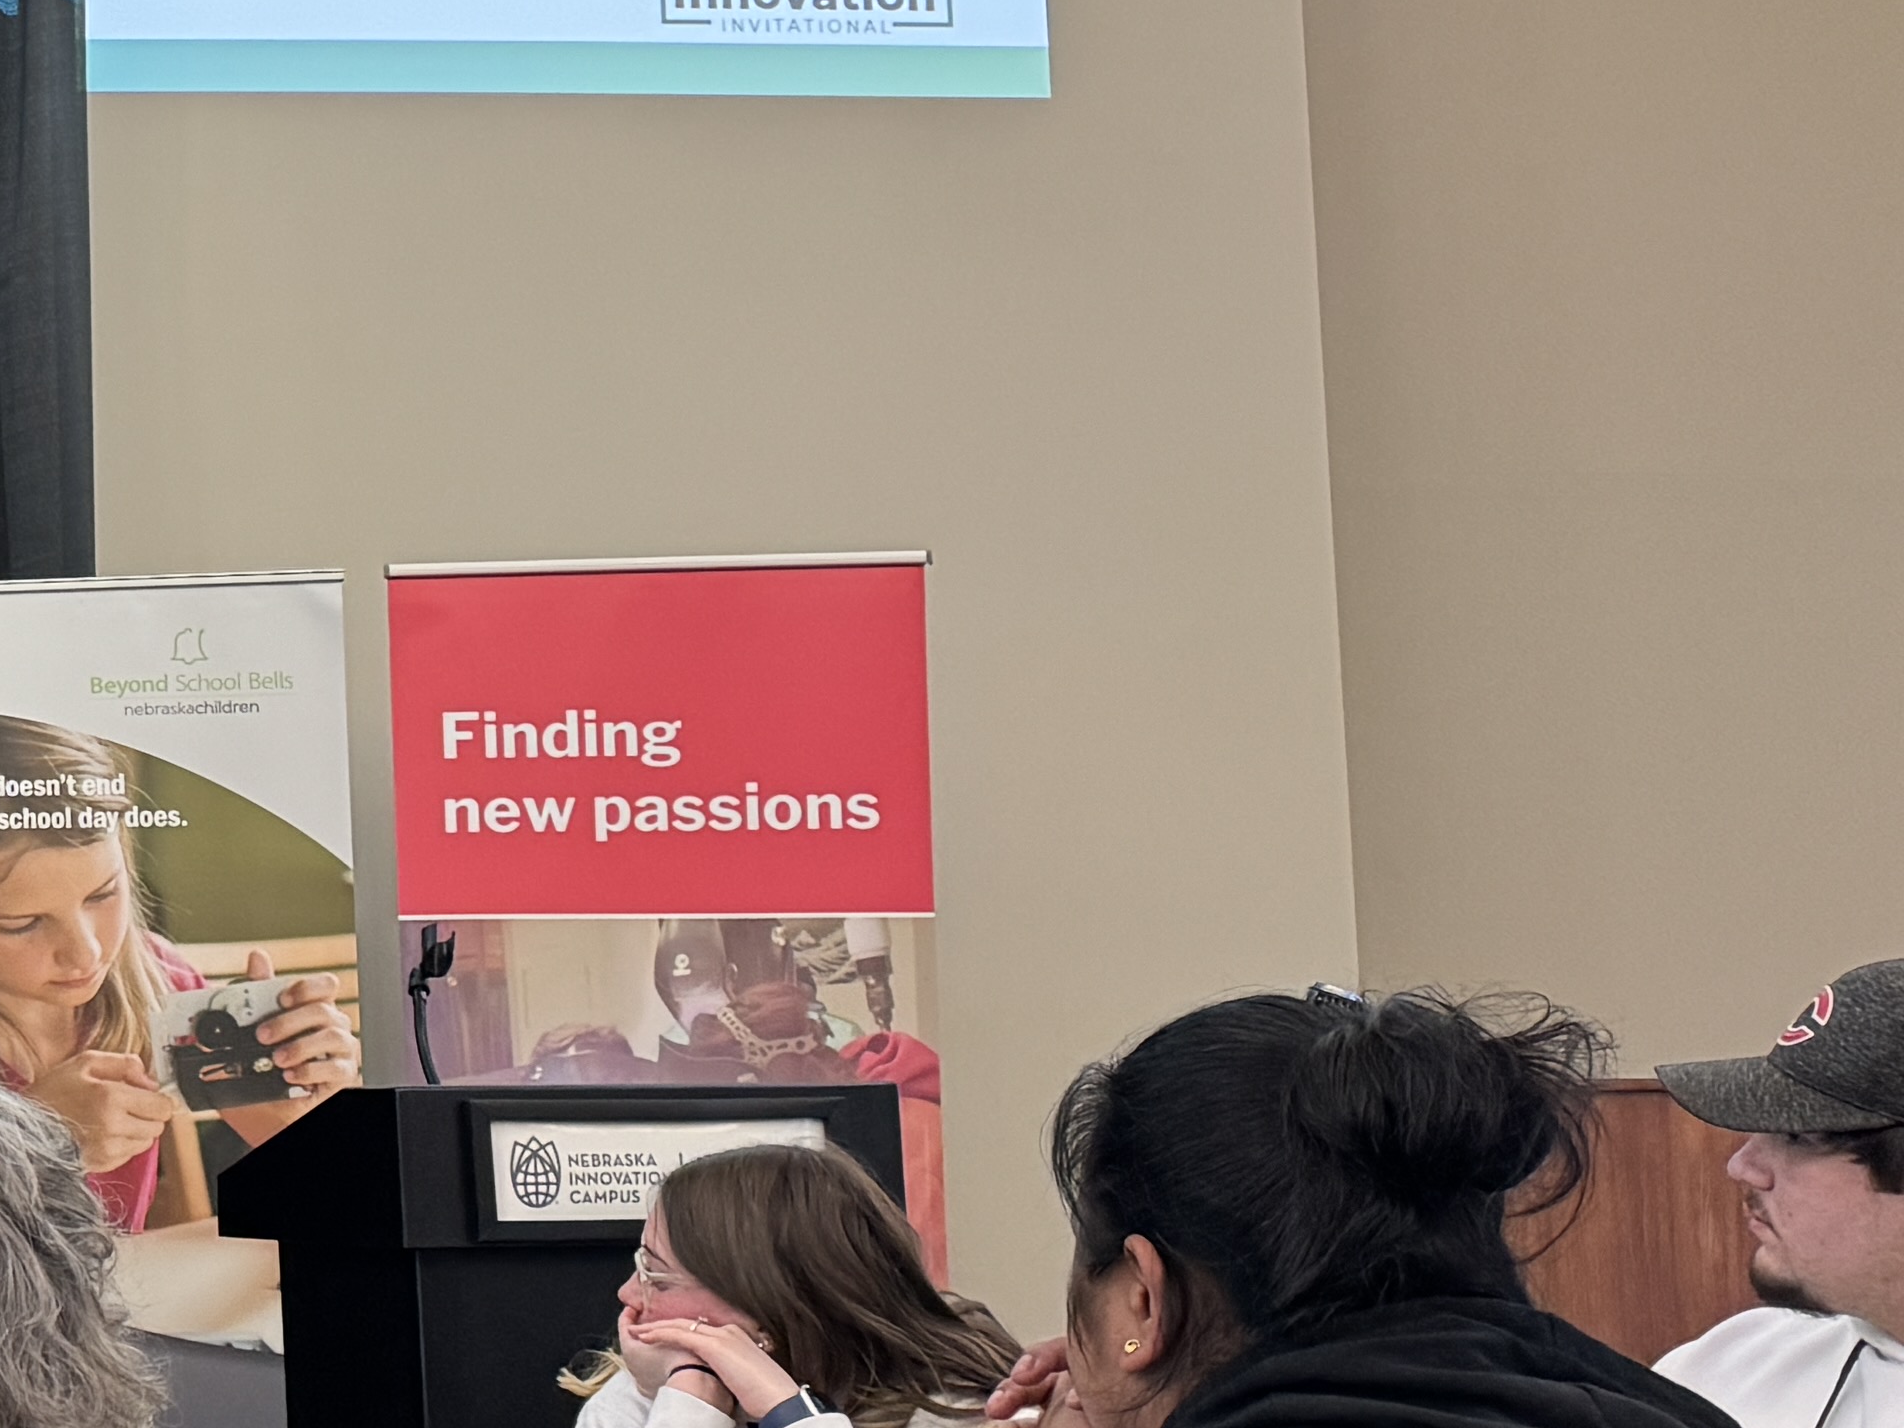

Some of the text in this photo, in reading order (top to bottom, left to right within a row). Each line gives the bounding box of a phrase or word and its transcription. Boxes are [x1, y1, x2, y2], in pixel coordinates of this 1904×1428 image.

[723, 18, 890, 34] INVITATIONAL
[91, 671, 294, 698] Beyond School Bells
[124, 700, 260, 716] nebraskachildren
[443, 710, 681, 766] Finding
[83, 774, 125, 796] end
[78, 806, 118, 833] day
[124, 805, 188, 828] does.
[445, 782, 879, 841] new passions
[567, 1153, 658, 1168] NEBRASKA
[569, 1189, 641, 1204] CAMPUS
